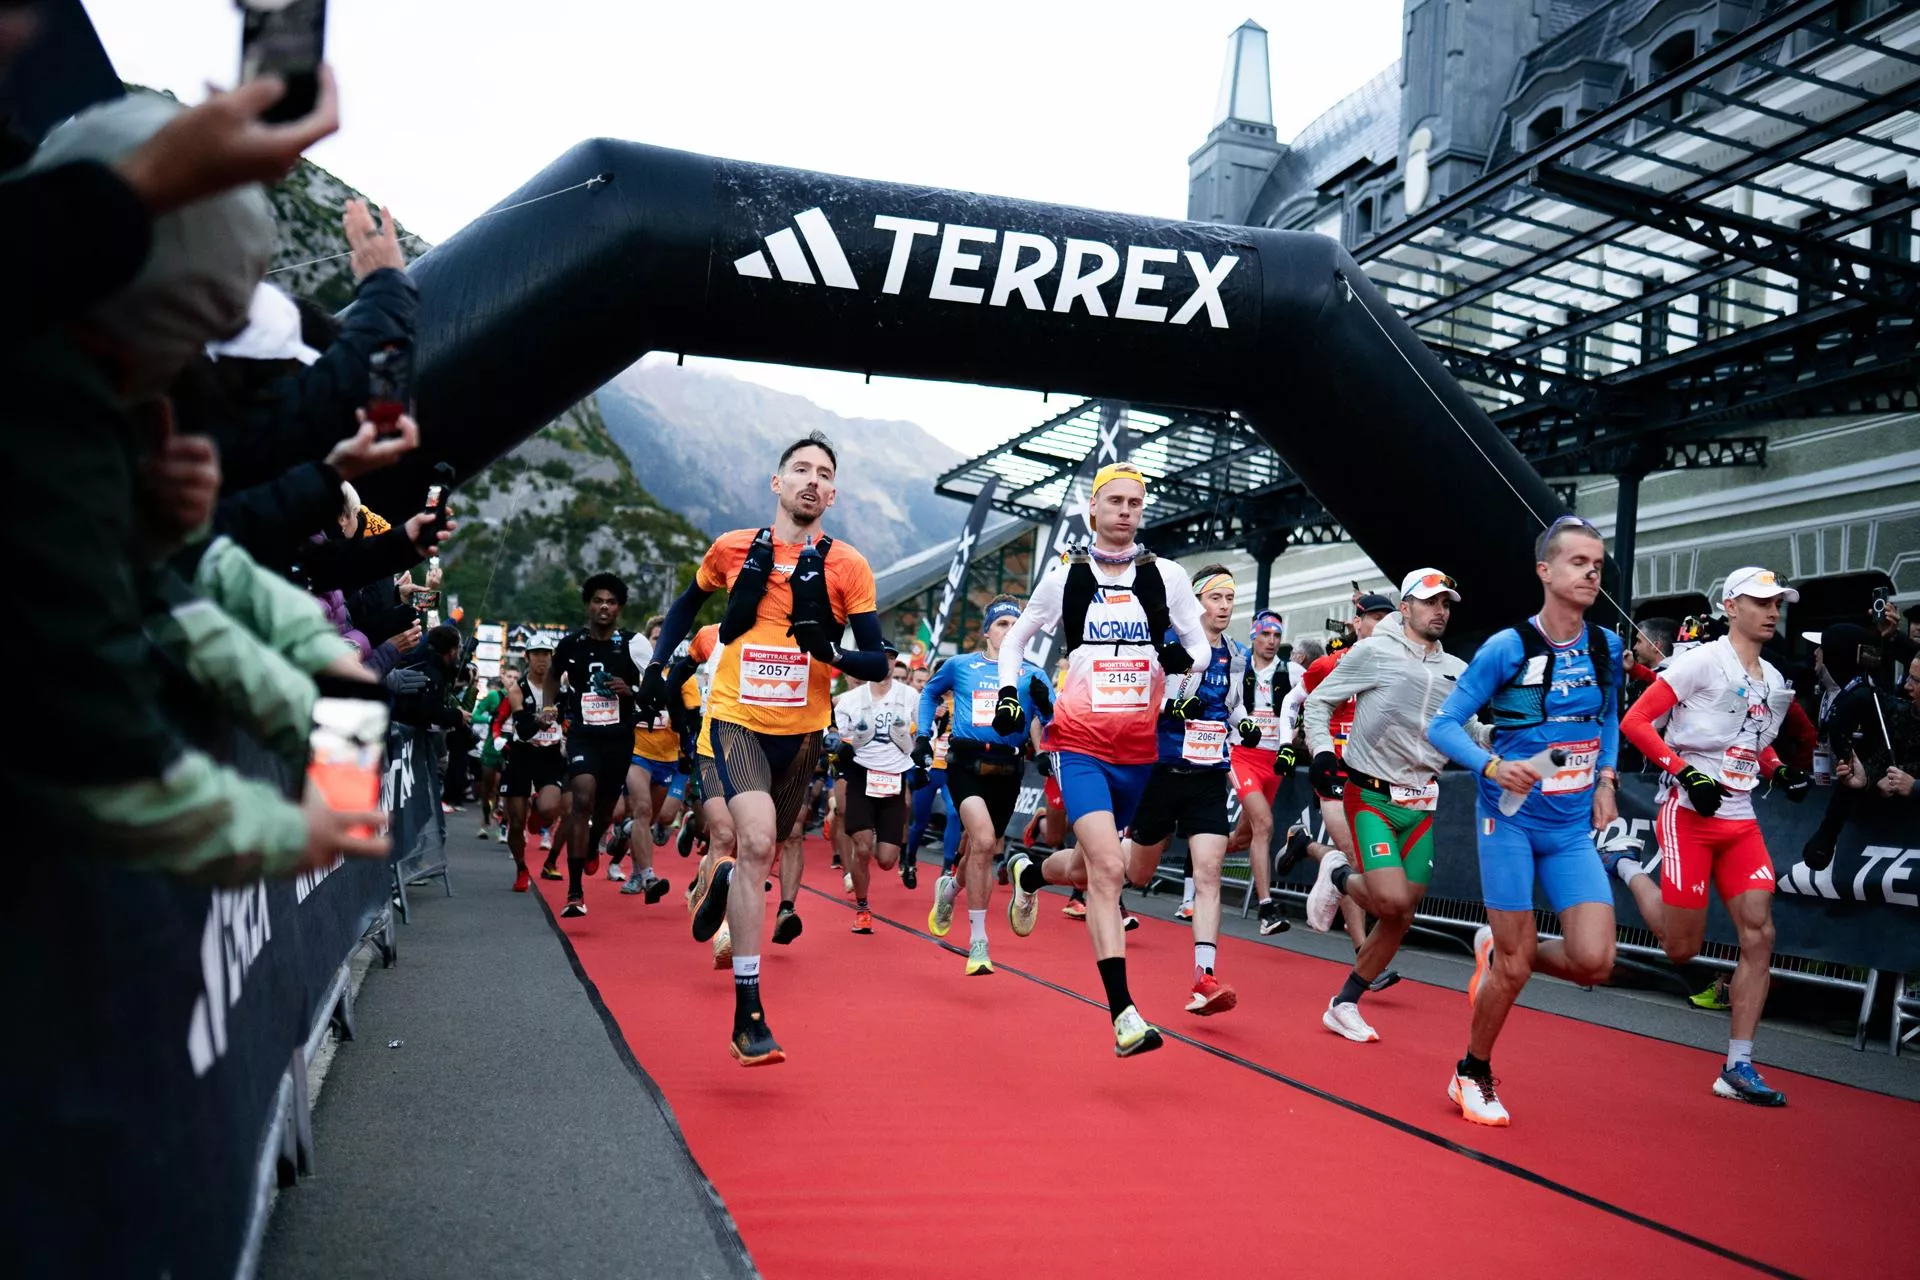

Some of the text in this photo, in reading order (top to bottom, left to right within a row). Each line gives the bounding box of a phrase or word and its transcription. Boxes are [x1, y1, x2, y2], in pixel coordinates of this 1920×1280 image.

[873, 214, 1240, 330] TERREX
[1088, 621, 1149, 640] NORWAY
[749, 651, 788, 660] SHORTTRAIL
[758, 664, 791, 677] 2057
[1108, 672, 1137, 683] 2145
[980, 681, 999, 690] ITAL
[1197, 732, 1217, 741] 2064
[1568, 754, 1590, 767] 104
[1734, 760, 1755, 773] 2071
[1404, 786, 1428, 797] 2167
